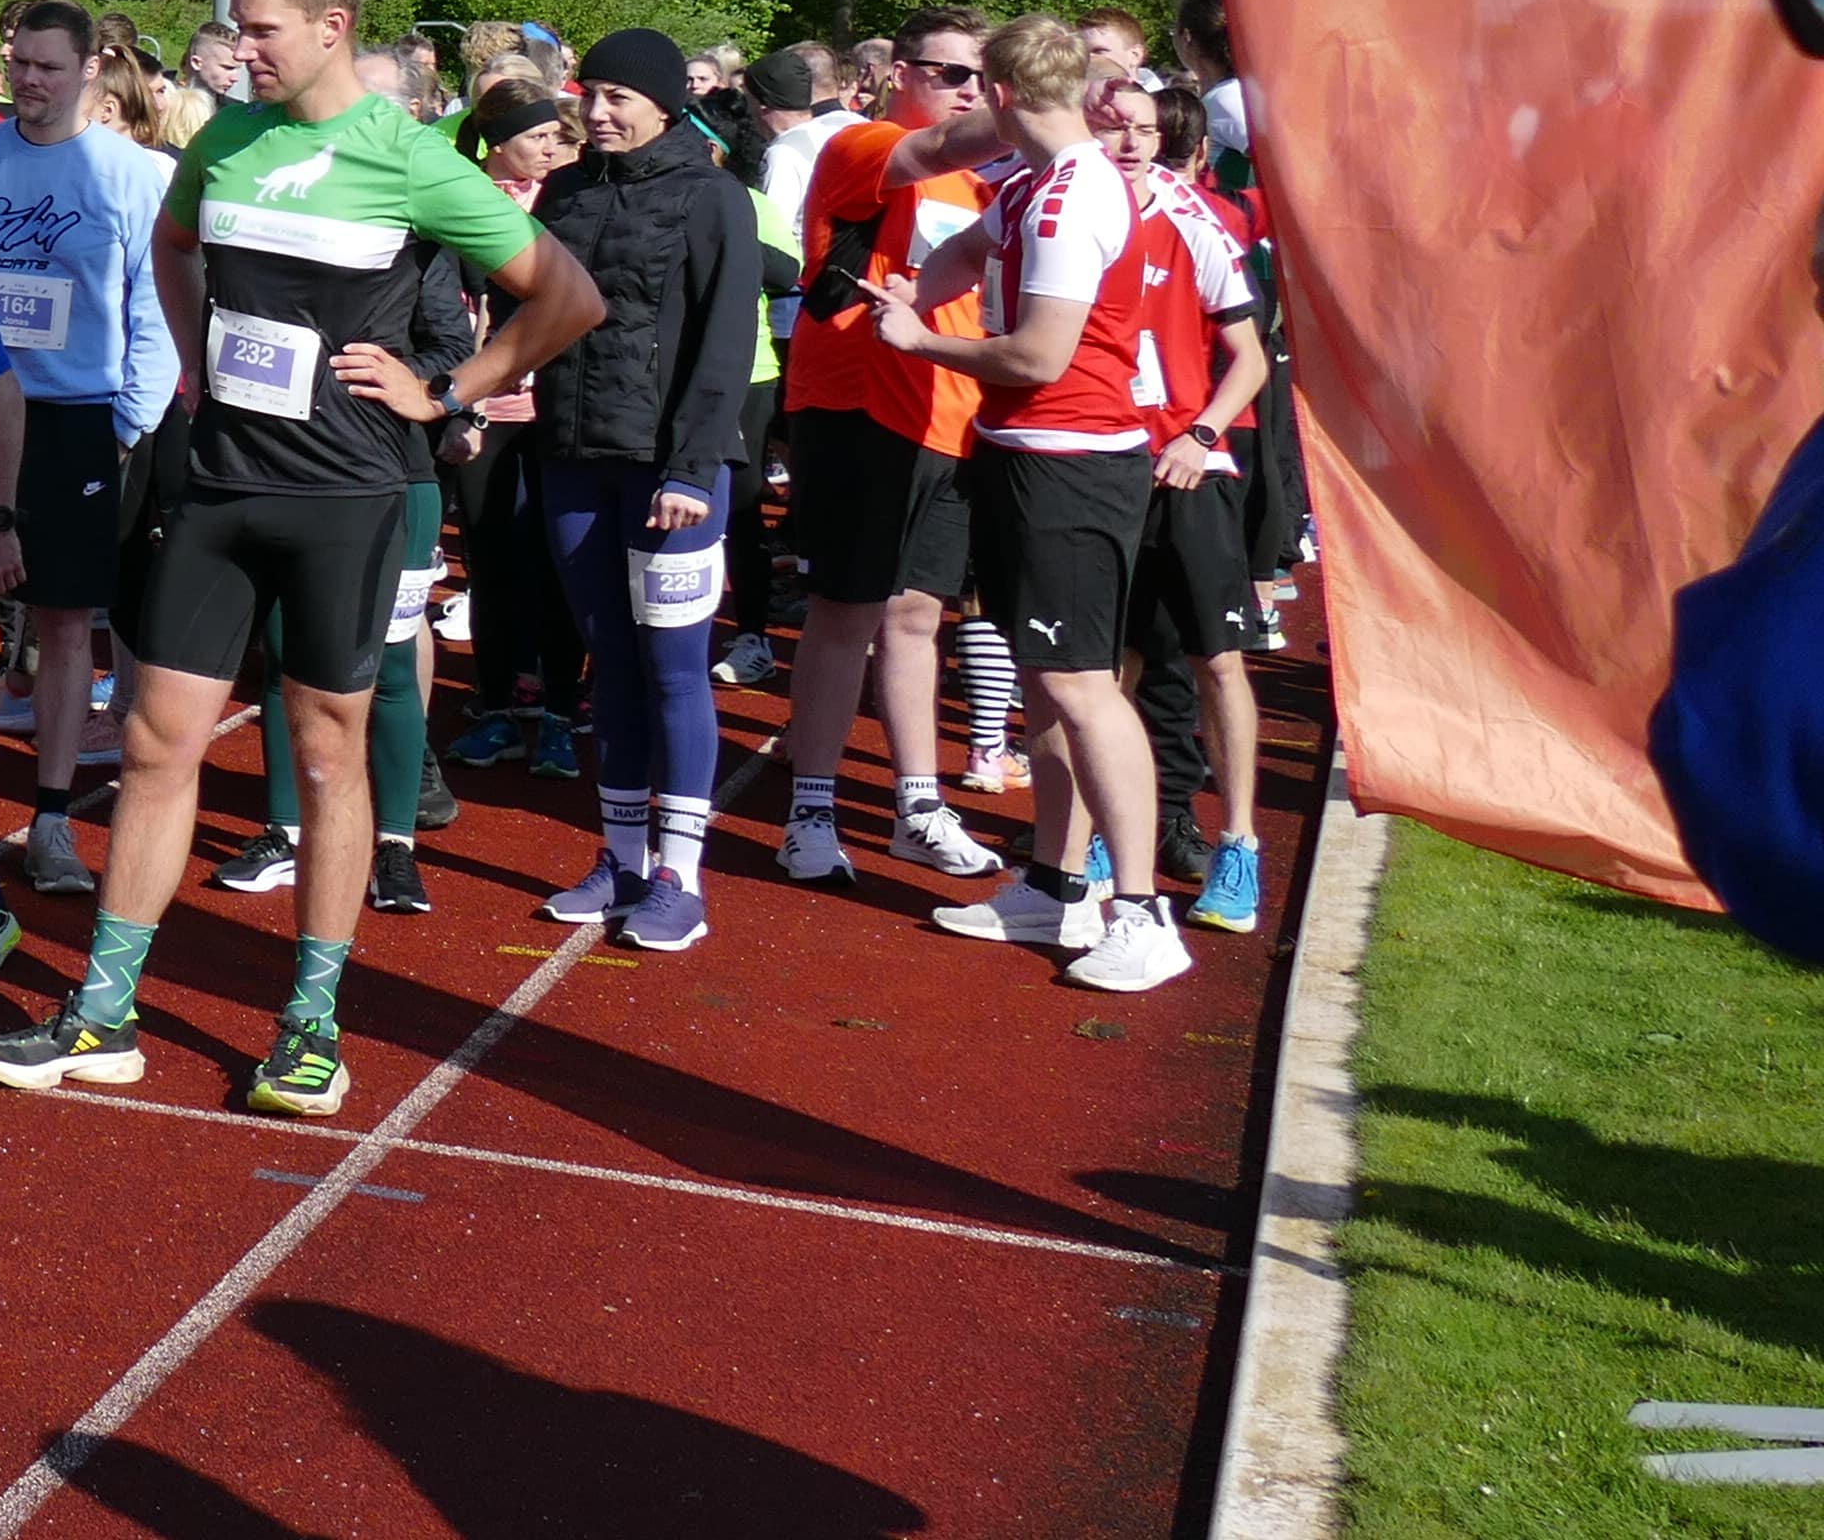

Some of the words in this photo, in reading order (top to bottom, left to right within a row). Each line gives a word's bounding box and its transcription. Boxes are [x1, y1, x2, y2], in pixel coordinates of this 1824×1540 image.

[0, 295, 36, 316] 164
[233, 339, 275, 369] 232
[659, 571, 700, 592] 229
